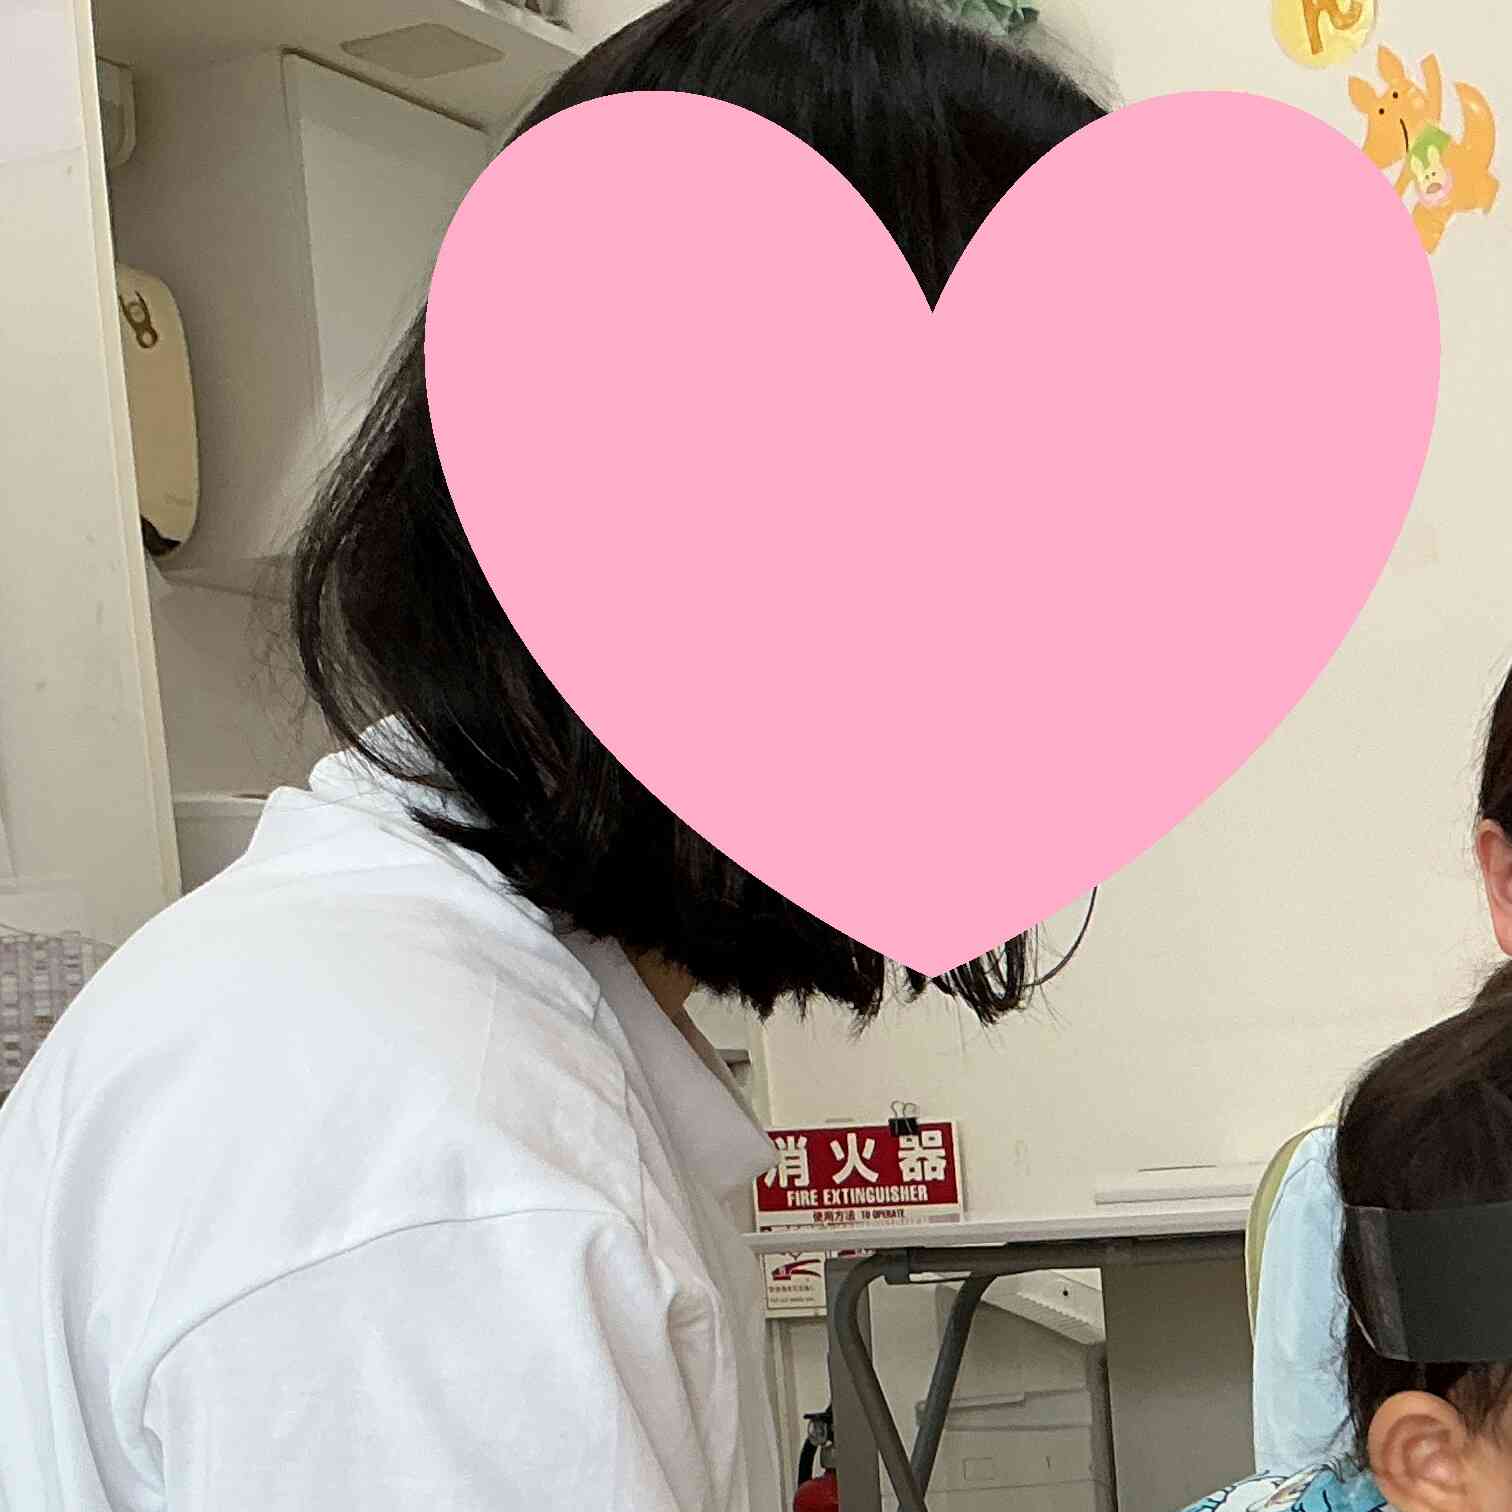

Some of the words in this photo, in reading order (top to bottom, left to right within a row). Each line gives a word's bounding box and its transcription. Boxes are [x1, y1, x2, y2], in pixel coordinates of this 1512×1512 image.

[764, 1130, 947, 1188] 消火器
[787, 1188, 819, 1207] FIRE
[823, 1184, 929, 1205] EXTINGUISHER
